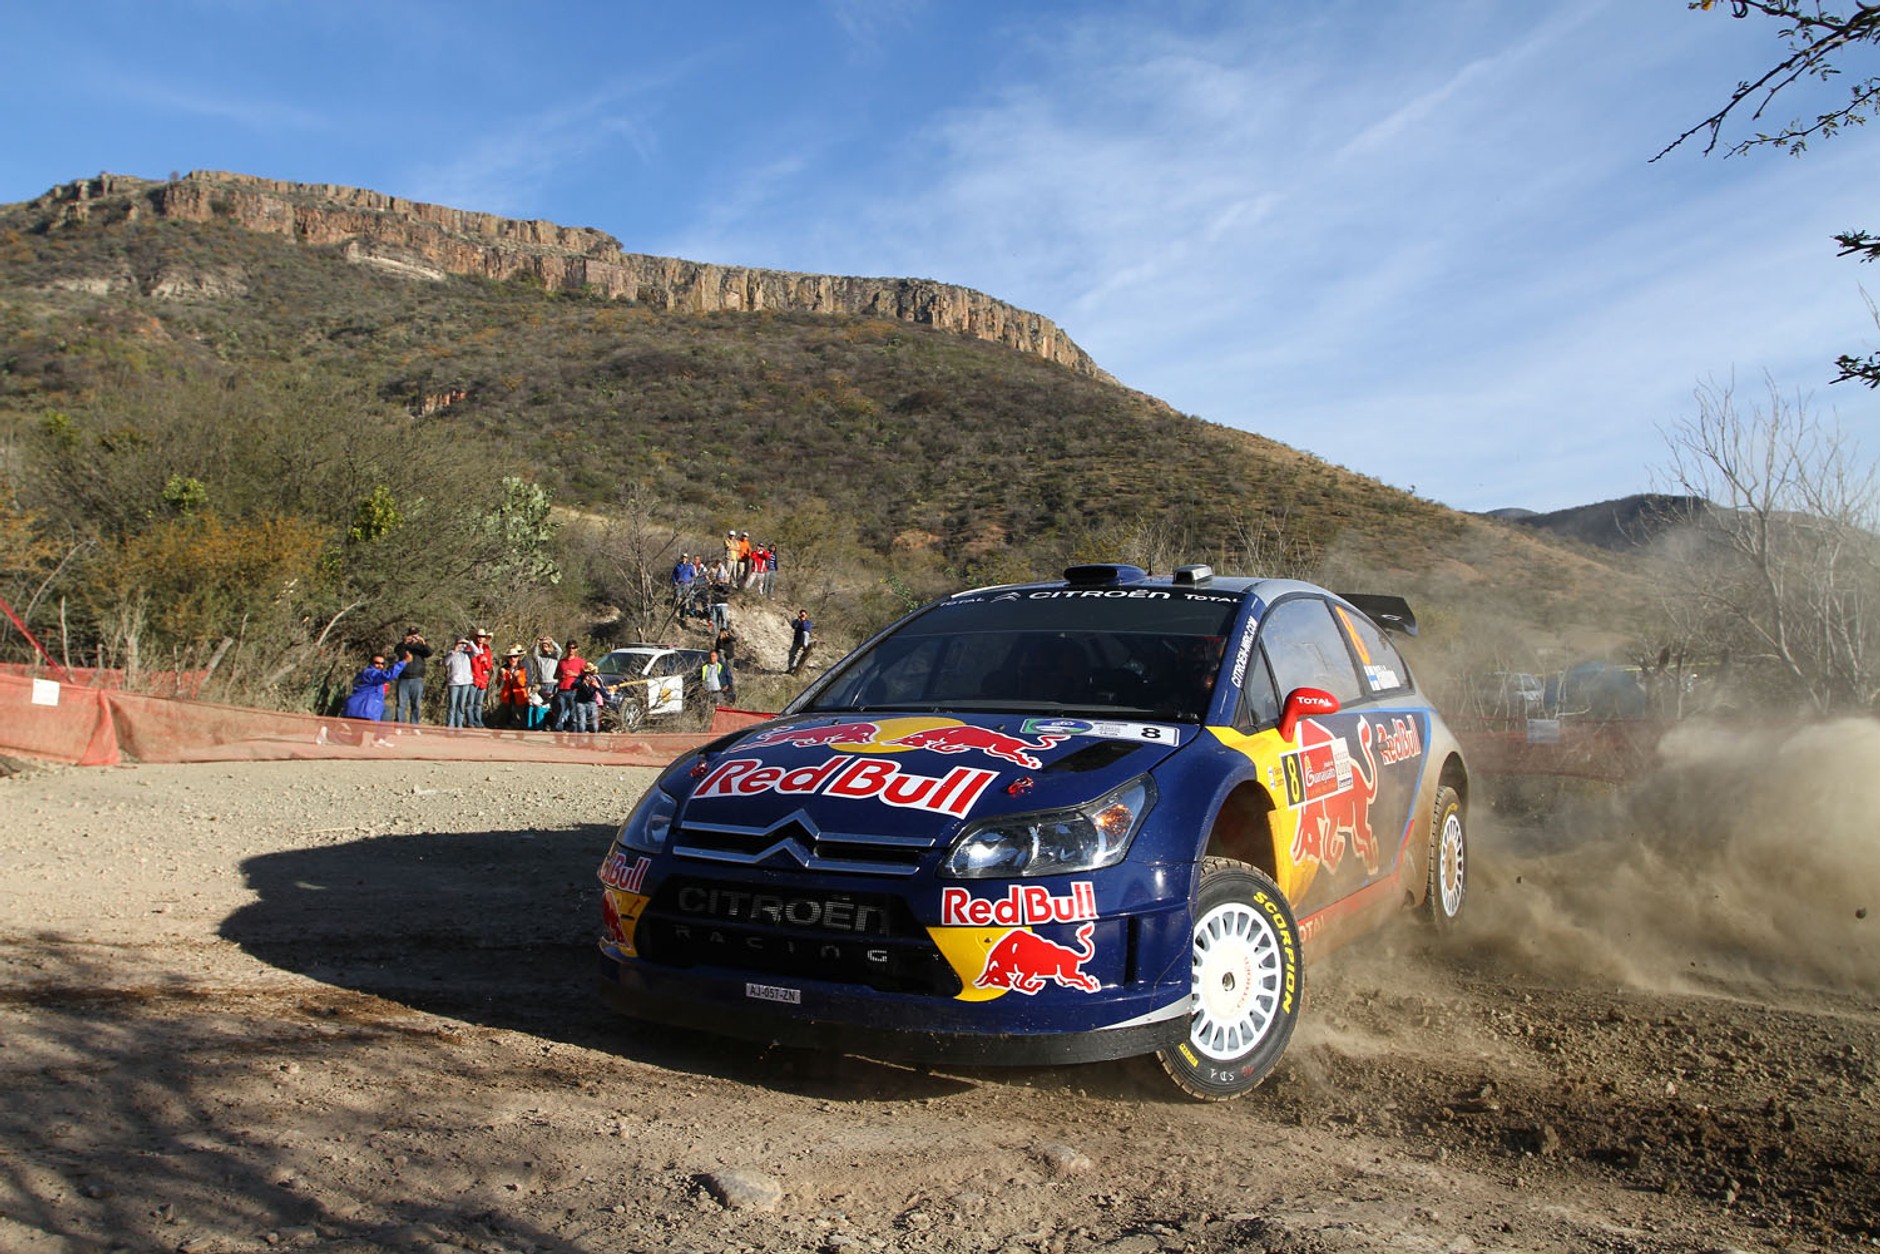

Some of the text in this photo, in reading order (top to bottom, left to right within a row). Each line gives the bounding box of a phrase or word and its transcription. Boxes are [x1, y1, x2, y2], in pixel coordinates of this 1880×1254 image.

[1184, 593, 1242, 603] TOTAL
[1296, 696, 1332, 706] TOTAL
[1140, 727, 1162, 739] 8
[691, 754, 1001, 820] Red Bull
[1287, 755, 1300, 802] 8
[942, 881, 1100, 926] Red Bull
[1253, 891, 1296, 1014] SCORPION
